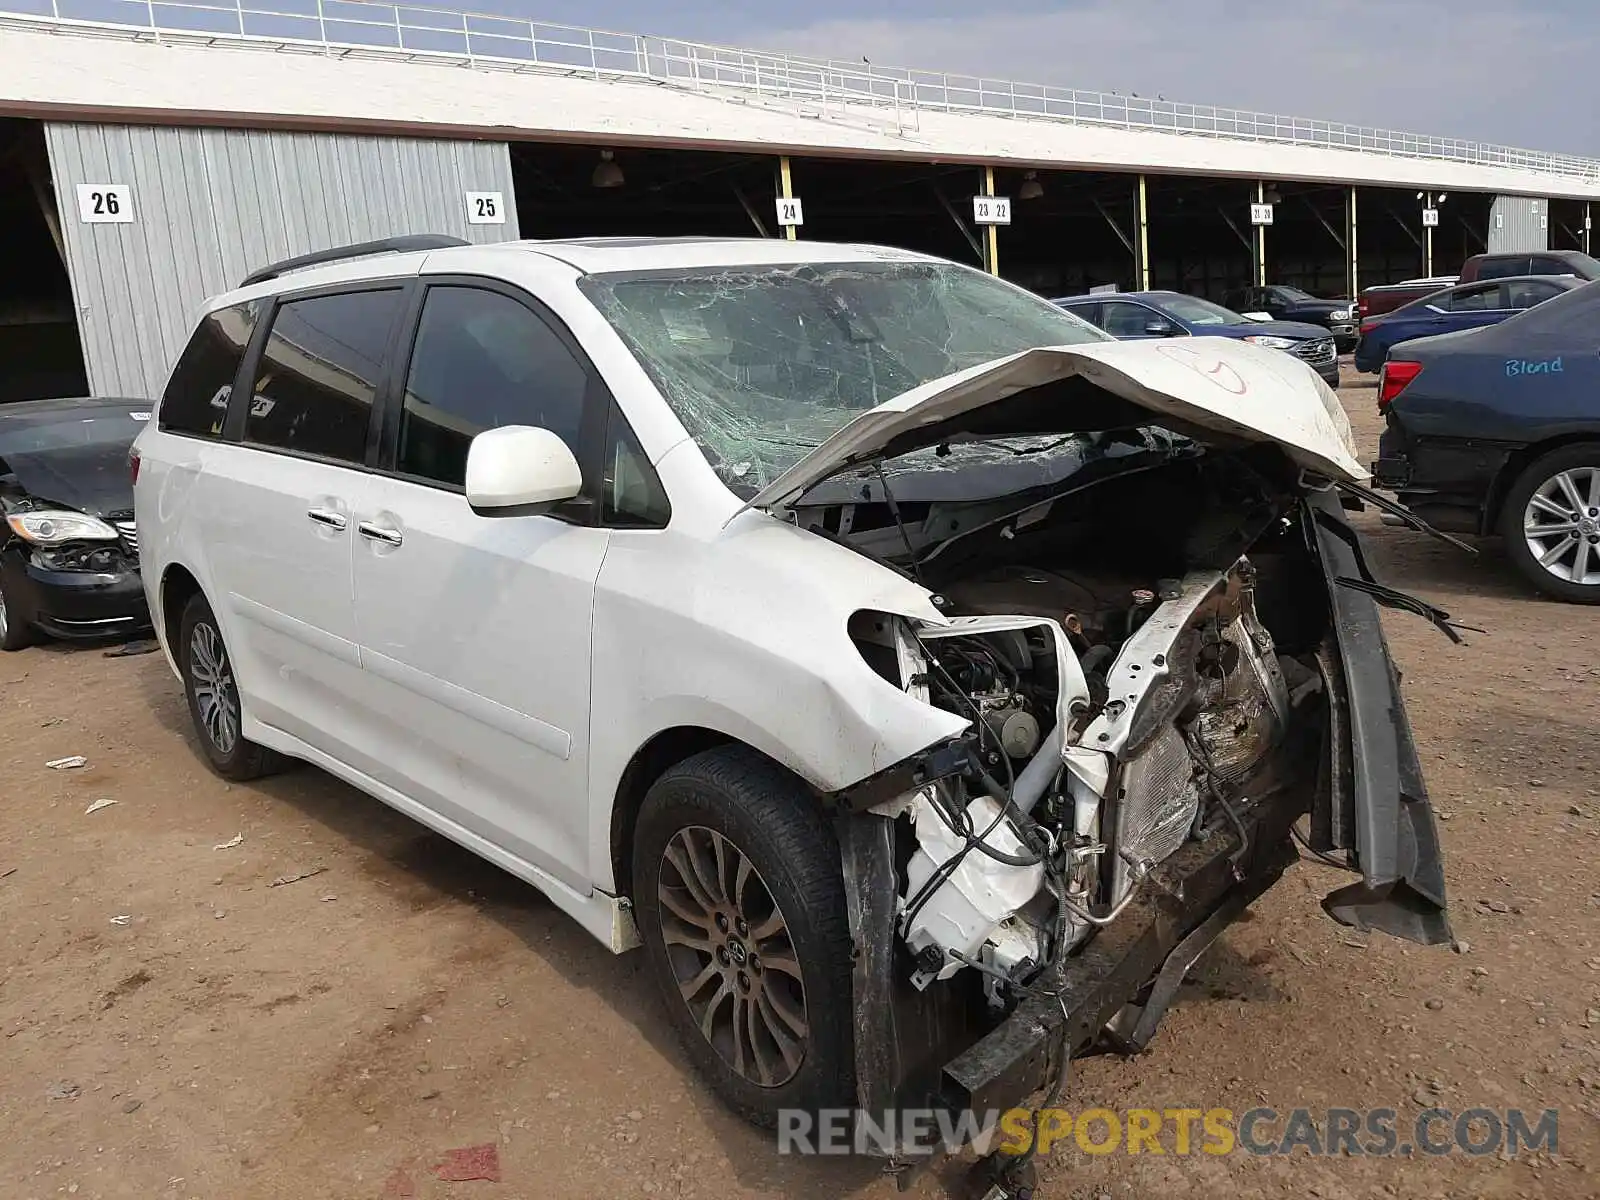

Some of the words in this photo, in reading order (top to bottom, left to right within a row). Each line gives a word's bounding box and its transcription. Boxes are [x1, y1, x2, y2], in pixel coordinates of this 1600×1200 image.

[91, 191, 120, 215] 26
[475, 198, 496, 218] 25
[783, 204, 796, 219] 24
[978, 203, 989, 217] 23
[996, 204, 1006, 217] 22
[1504, 356, 1564, 377] Blend
